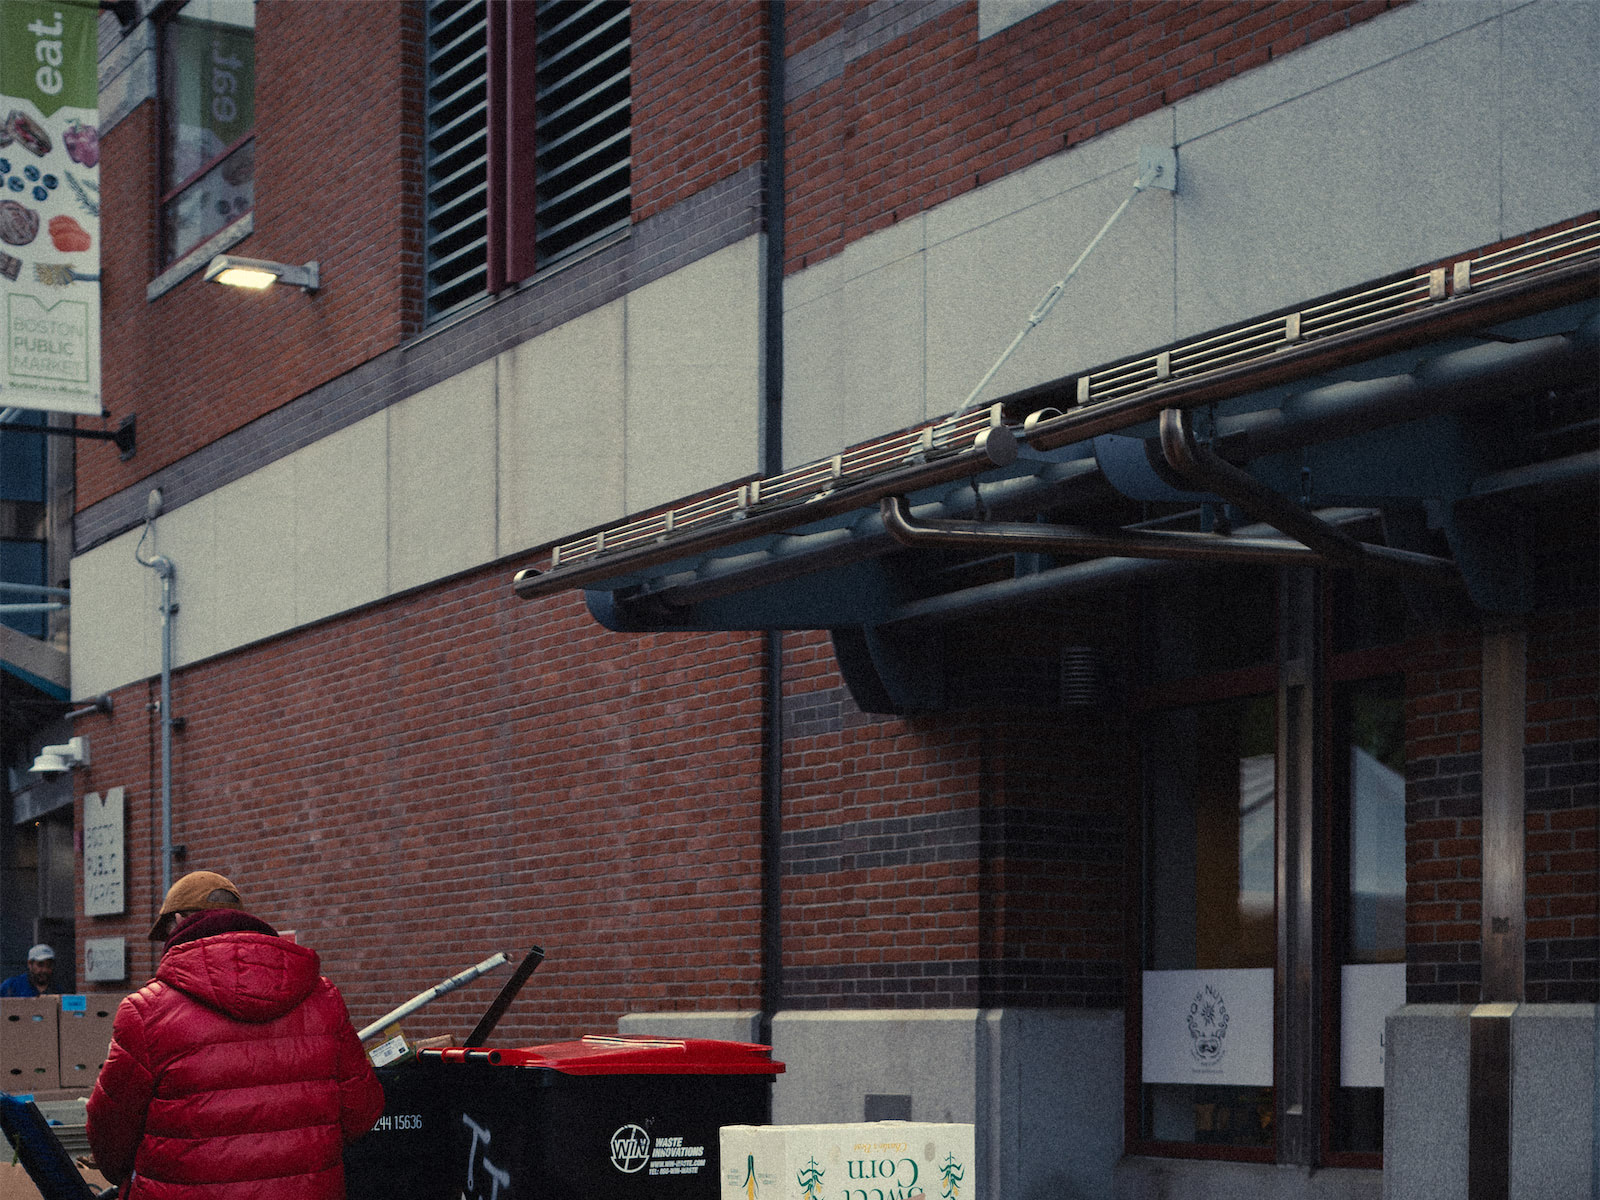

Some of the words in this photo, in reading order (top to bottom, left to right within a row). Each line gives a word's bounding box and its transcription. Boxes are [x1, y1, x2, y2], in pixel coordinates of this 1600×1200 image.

[28, 11, 63, 95] eat.
[14, 316, 84, 337] BOSTON
[14, 336, 74, 356] PUBLIC
[14, 356, 80, 376] MARKET
[394, 1114, 423, 1130] 15636
[655, 1137, 684, 1147] WASTE
[652, 1147, 704, 1158] INNOVATIONS
[847, 1158, 919, 1188] Corn
